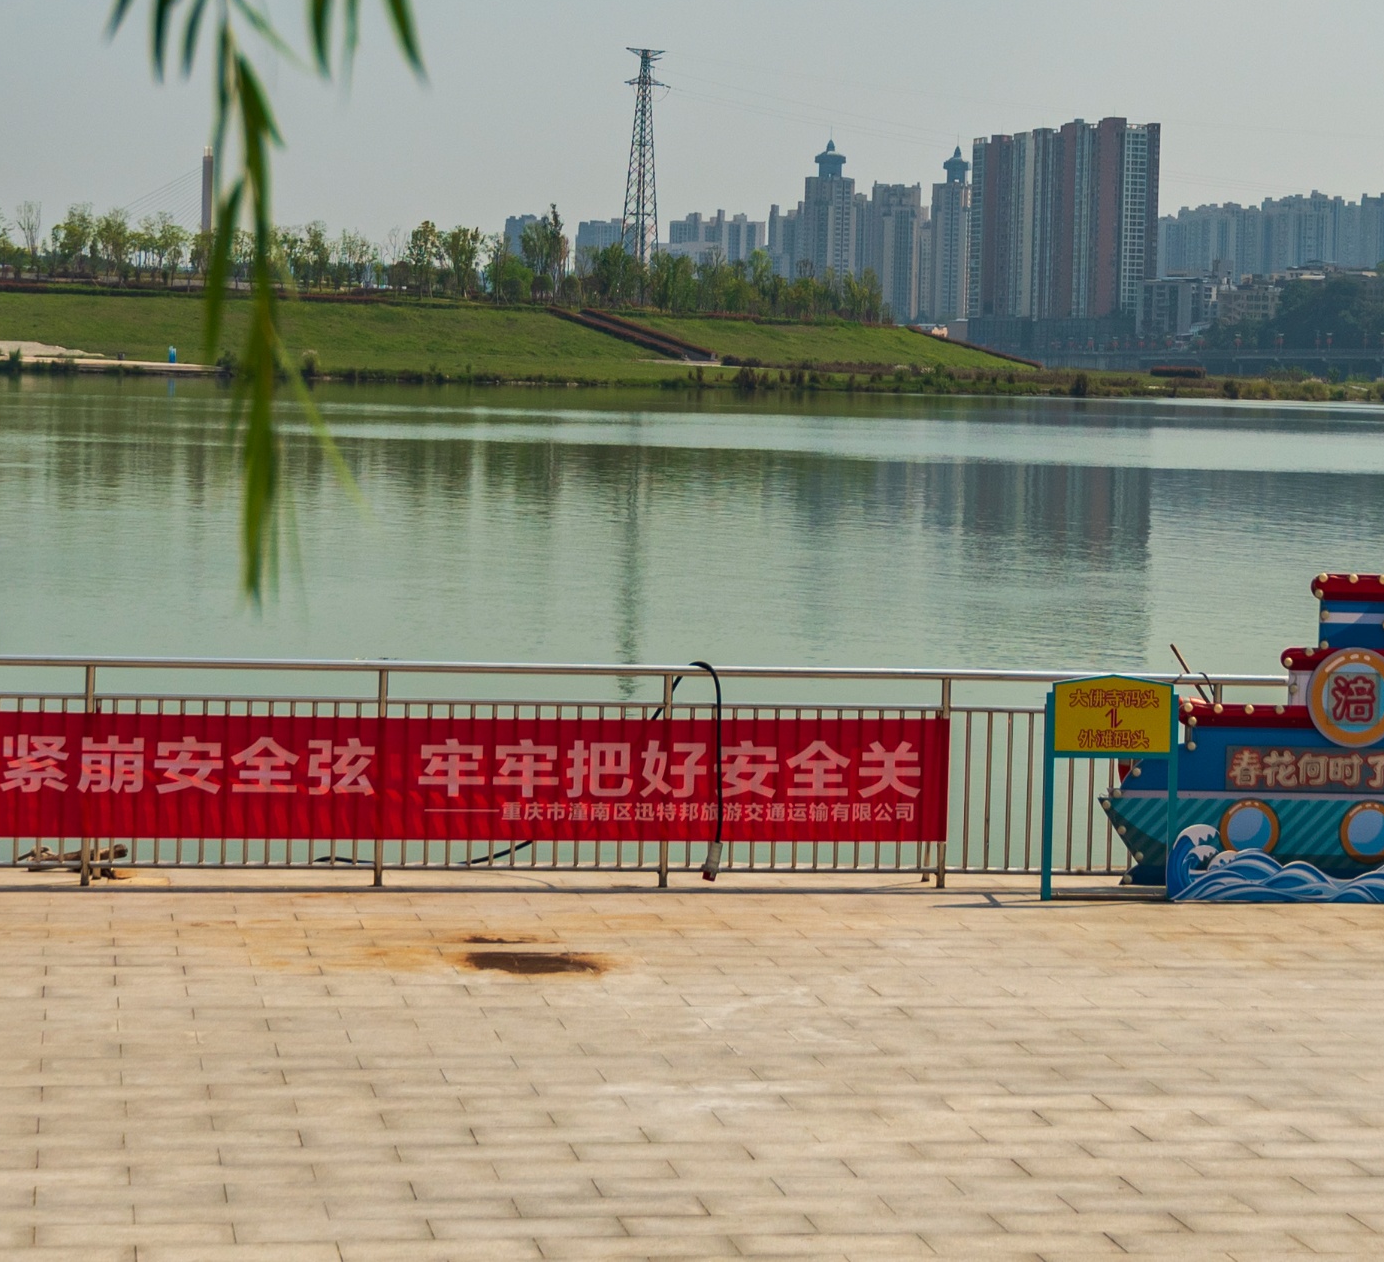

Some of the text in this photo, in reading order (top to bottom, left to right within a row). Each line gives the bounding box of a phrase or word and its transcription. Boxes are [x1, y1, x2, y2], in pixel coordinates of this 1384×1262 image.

[1069, 689, 1160, 709] 大佛寺码头
[1078, 729, 1150, 749] 外滩码头
[418, 738, 921, 799] 牢牢把好安全关
